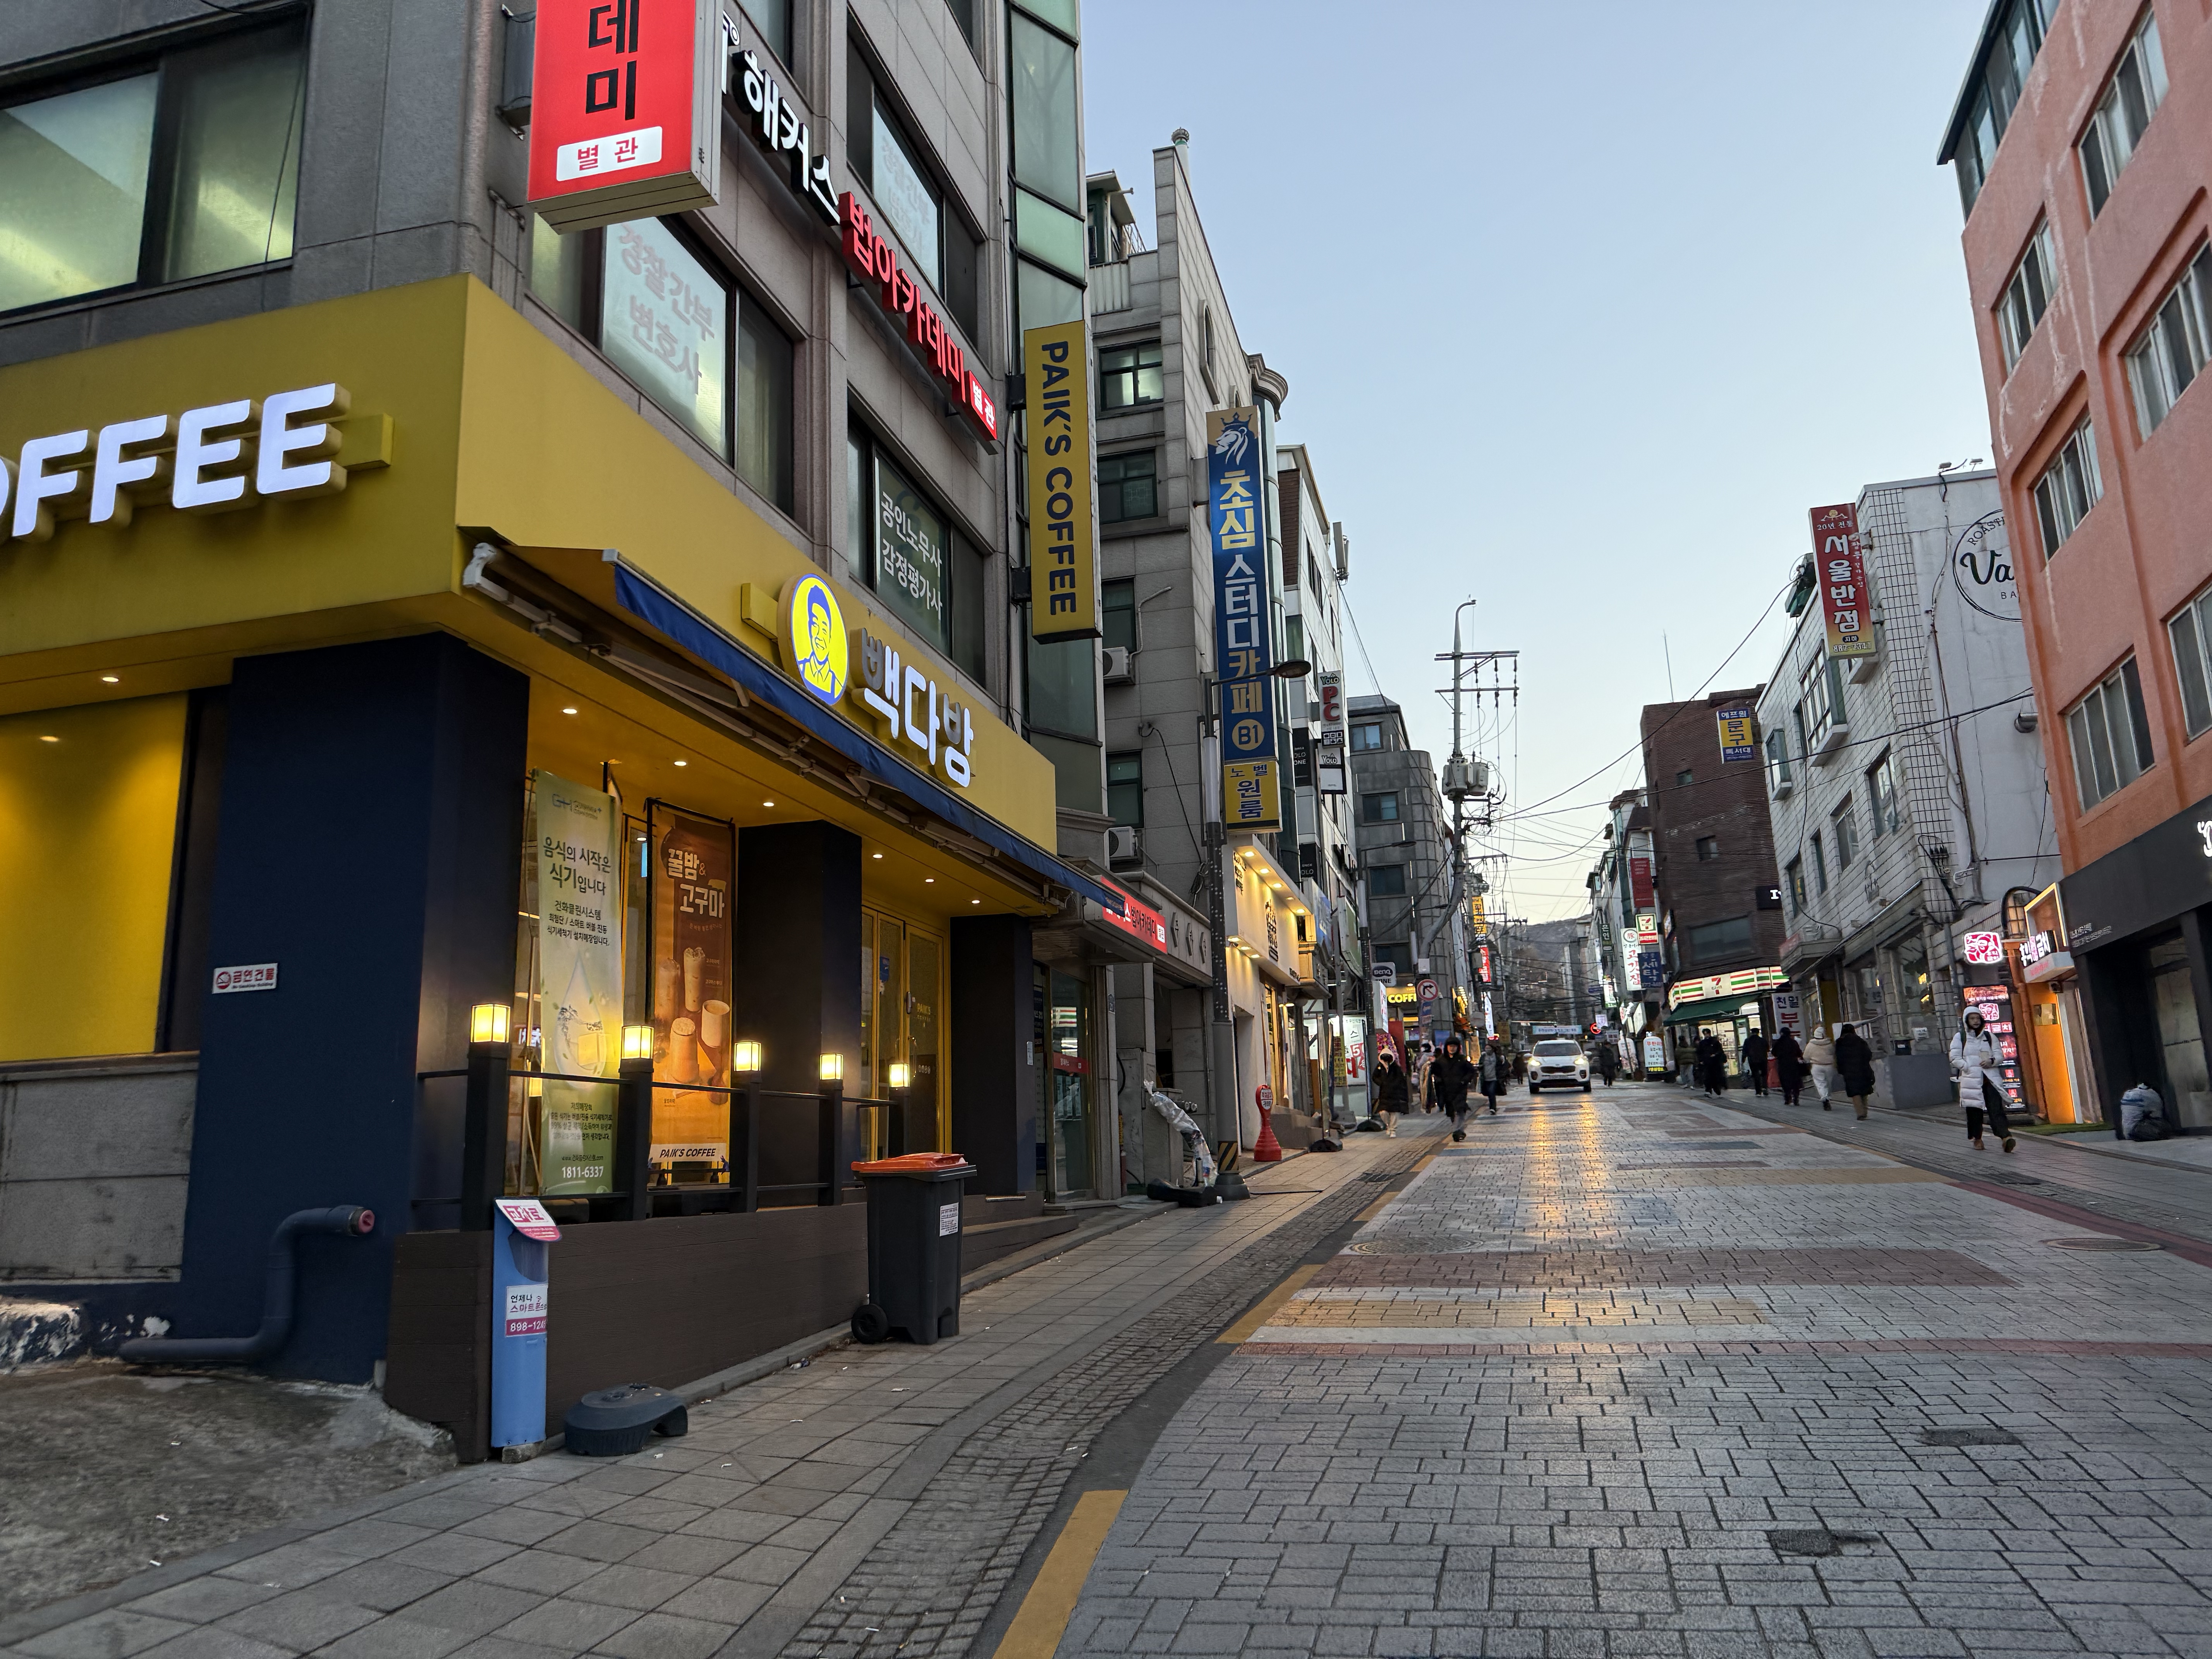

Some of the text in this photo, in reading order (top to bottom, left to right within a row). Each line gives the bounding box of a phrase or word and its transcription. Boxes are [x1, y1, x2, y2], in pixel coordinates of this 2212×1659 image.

[744, 50, 840, 225] 해커스
[850, 192, 966, 403] 법아카데미
[0, 383, 336, 538] FFEE
[1042, 341, 1077, 615] PAIK'S COFFEE
[881, 491, 942, 577] 공인노무사
[882, 538, 943, 620] 감정평가사
[1825, 534, 1859, 632] 서울반점
[1320, 674, 1340, 685] YOLO
[862, 628, 974, 788] 빽다방
[1238, 725, 1259, 745] B1
[1237, 778, 1262, 819] 원룸
[543, 836, 611, 873] 음식의 시작은
[668, 848, 699, 881] 꿀밤
[550, 863, 606, 895] 식기입니다
[680, 884, 725, 918] 고구마
[562, 1166, 604, 1178] 1811-6337
[659, 1148, 716, 1158] PAIK'S COFFEE
[510, 1295, 532, 1303] 언제나
